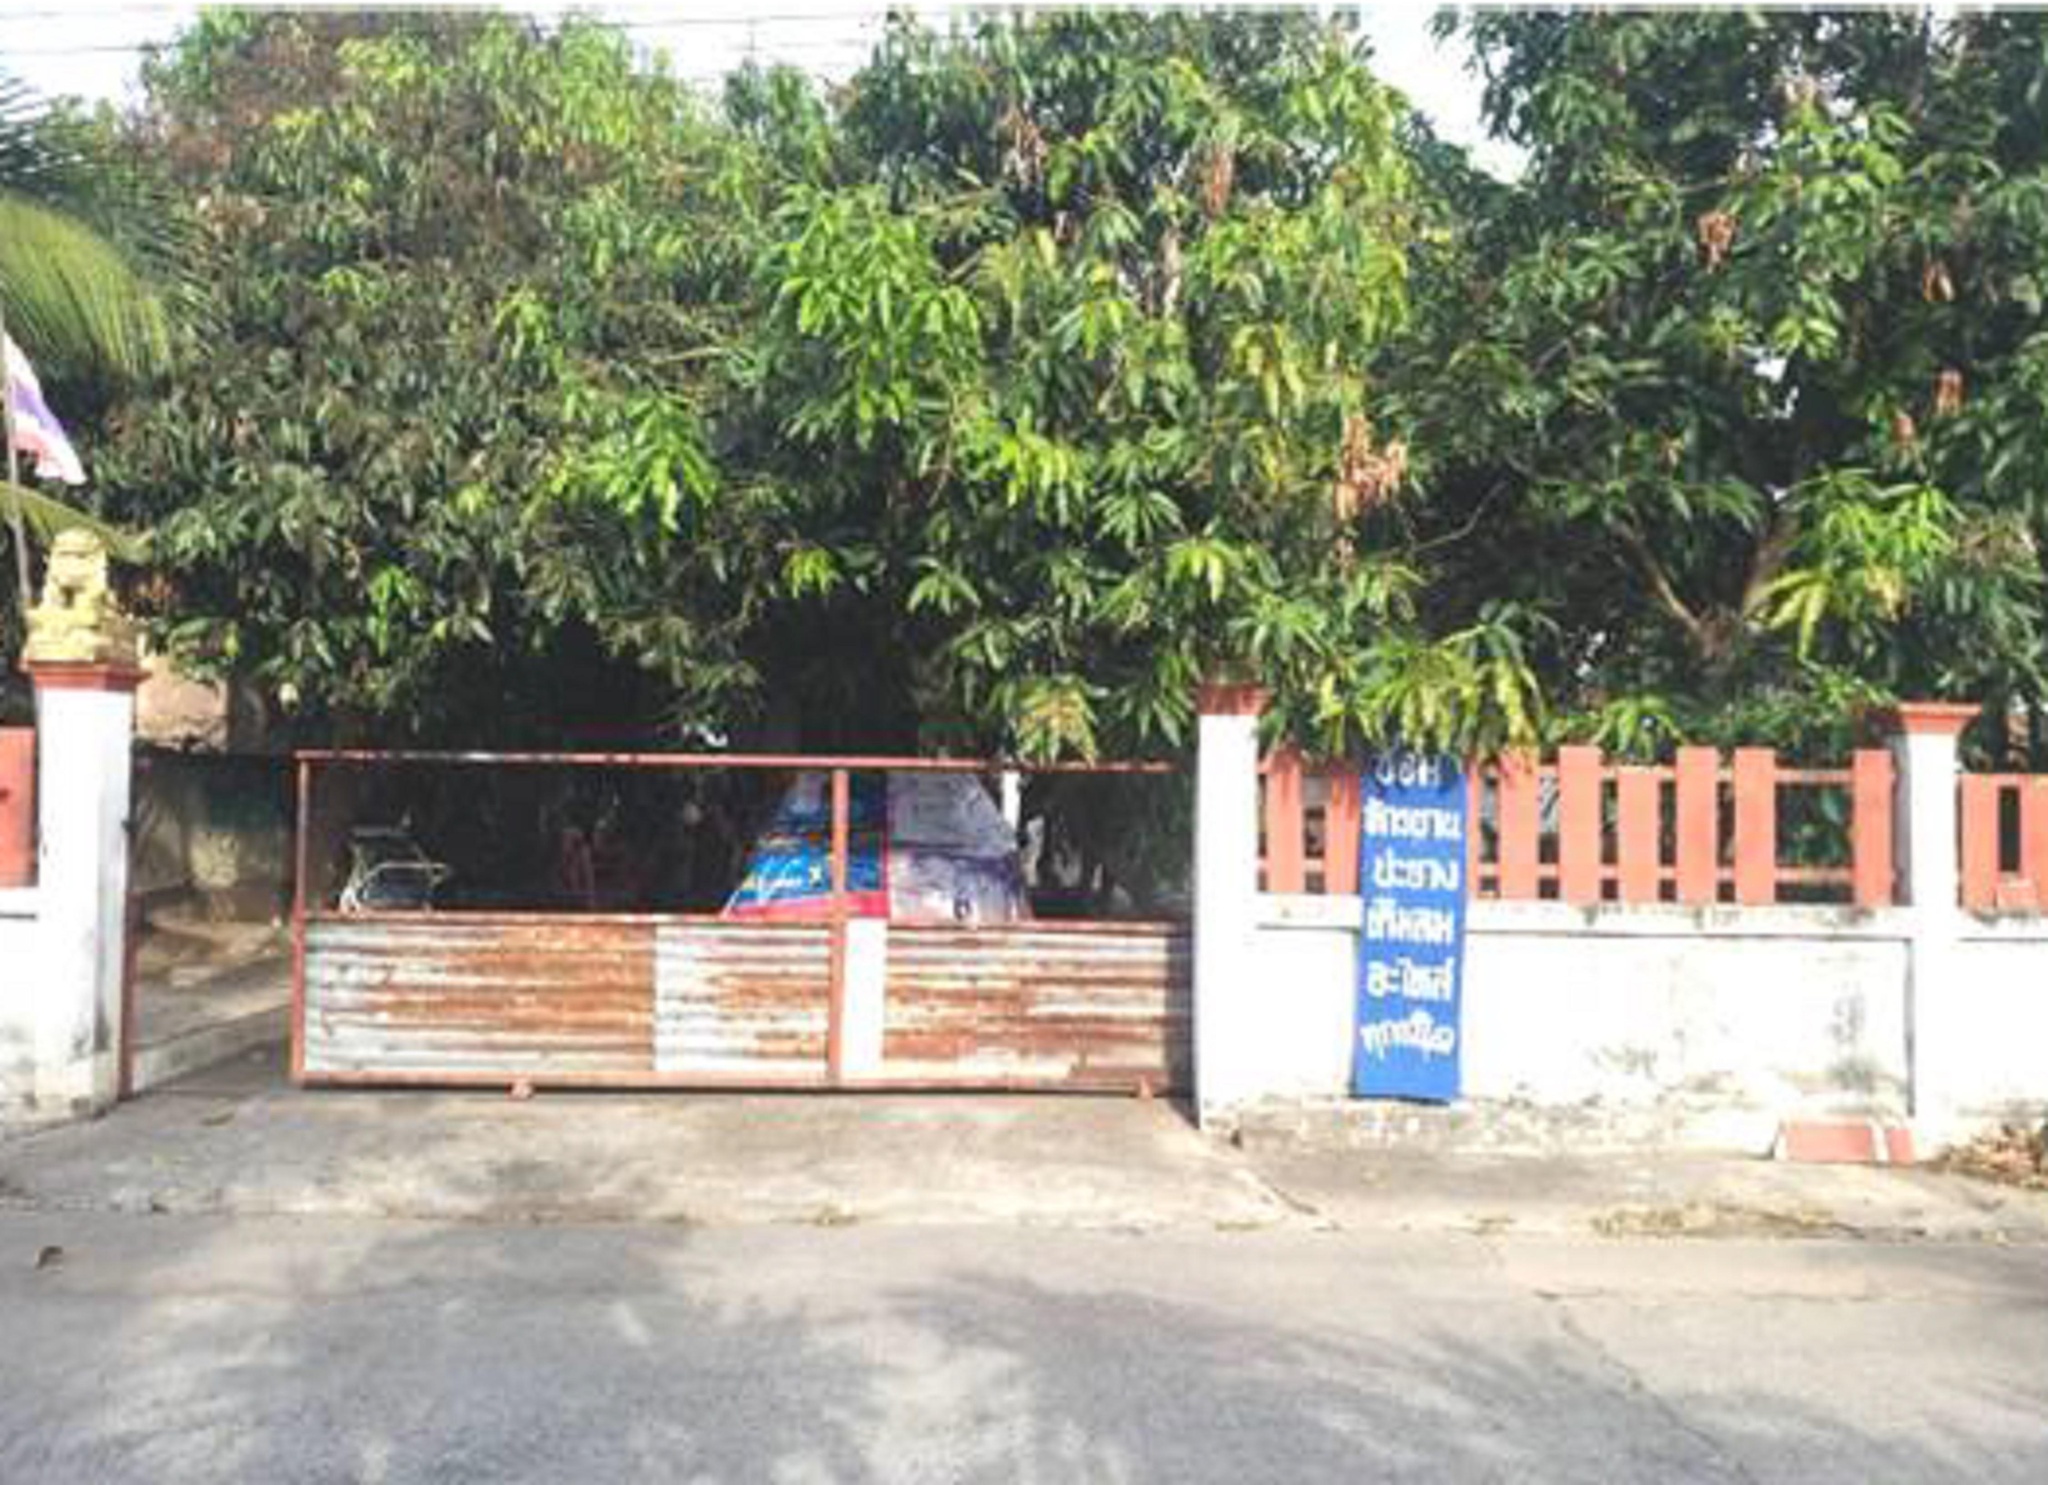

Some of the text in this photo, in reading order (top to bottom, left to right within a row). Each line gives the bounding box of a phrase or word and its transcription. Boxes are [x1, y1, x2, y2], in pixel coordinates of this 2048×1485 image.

[1375, 847, 1459, 891] ปะยาง
[1366, 956, 1455, 1001] อะไหล่
[1360, 1010, 1454, 1062] ทุกชนิด
